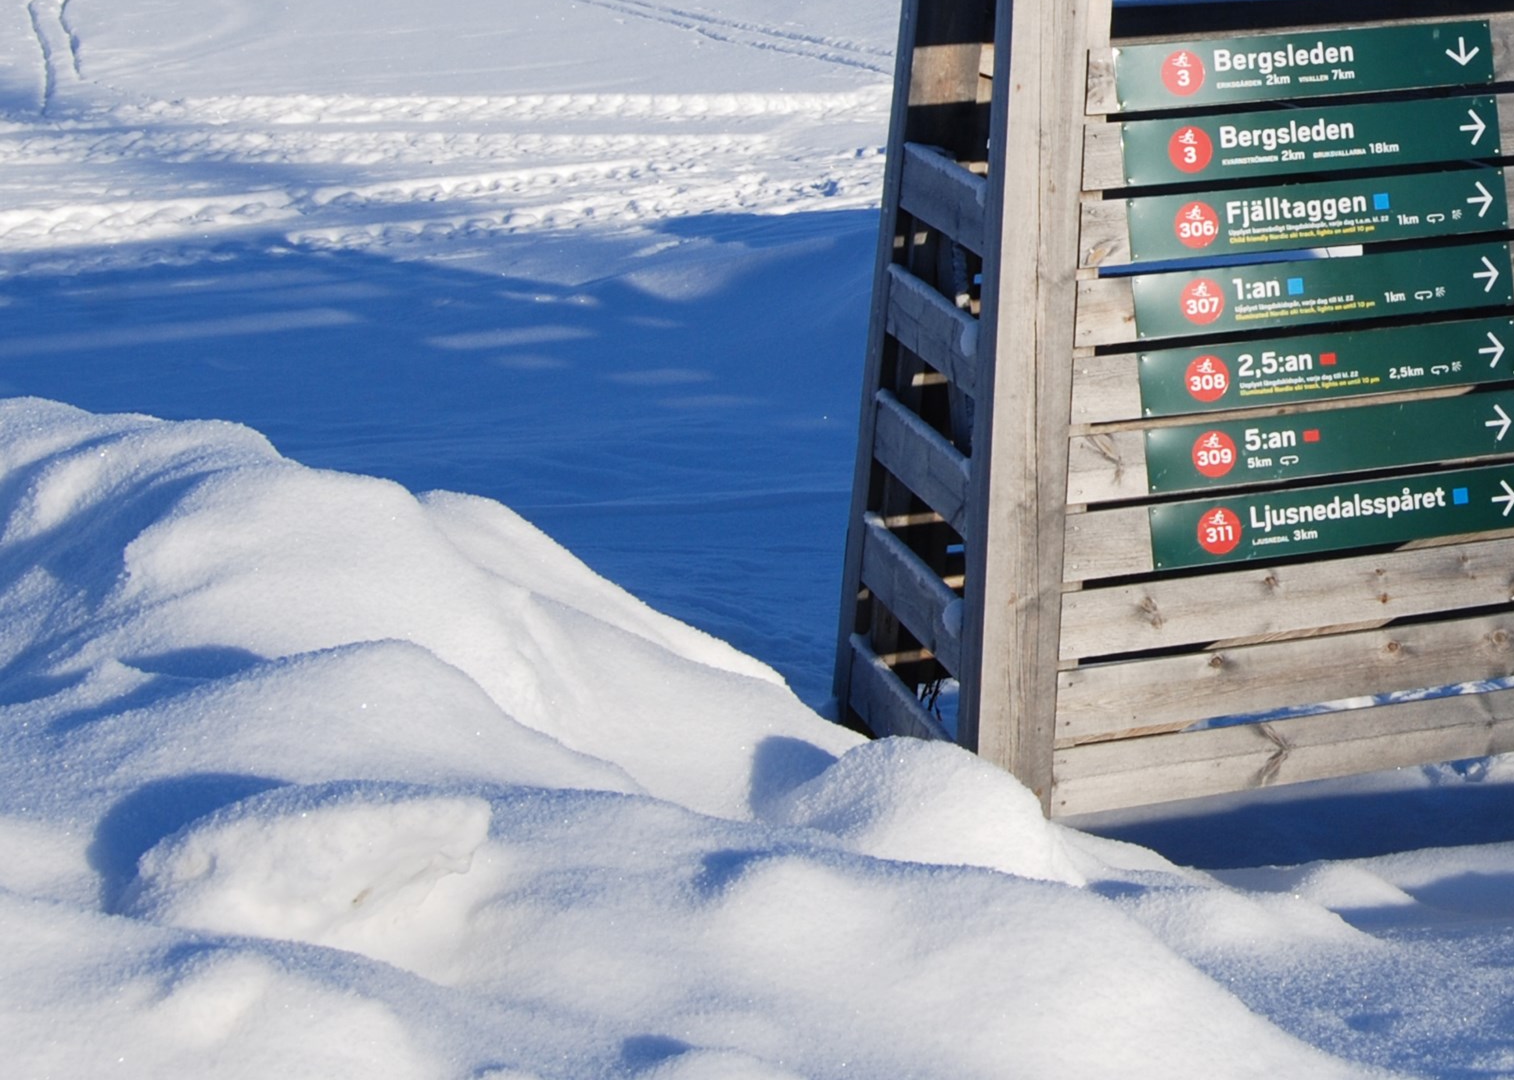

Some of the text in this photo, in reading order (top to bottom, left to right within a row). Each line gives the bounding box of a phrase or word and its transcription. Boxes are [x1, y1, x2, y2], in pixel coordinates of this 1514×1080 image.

[1213, 41, 1355, 75] Bergsleden
[1176, 69, 1190, 86] 3
[1266, 73, 1291, 86] 2km
[1331, 69, 1355, 81] 7km
[1219, 118, 1354, 151] Bergsleden
[1183, 146, 1196, 163] 3
[1281, 149, 1305, 162] 2km
[1369, 142, 1399, 154] 18km
[1226, 195, 1367, 228] Fjälltaggen
[1397, 214, 1419, 225] 1km
[1179, 220, 1214, 238] 306
[1232, 277, 1281, 300] 1:an
[1384, 291, 1406, 303] 1km
[1186, 296, 1219, 315] 307
[1237, 351, 1313, 378] 2,5:an
[1389, 365, 1424, 379] 2,5km
[1190, 373, 1226, 391] 308
[1244, 428, 1296, 451] 5:an
[1197, 448, 1232, 466] 309
[1247, 457, 1272, 469] 5km
[1249, 487, 1446, 532] Ljusnedalsspåret
[1205, 525, 1233, 543] 311
[1293, 529, 1318, 541] 3km
